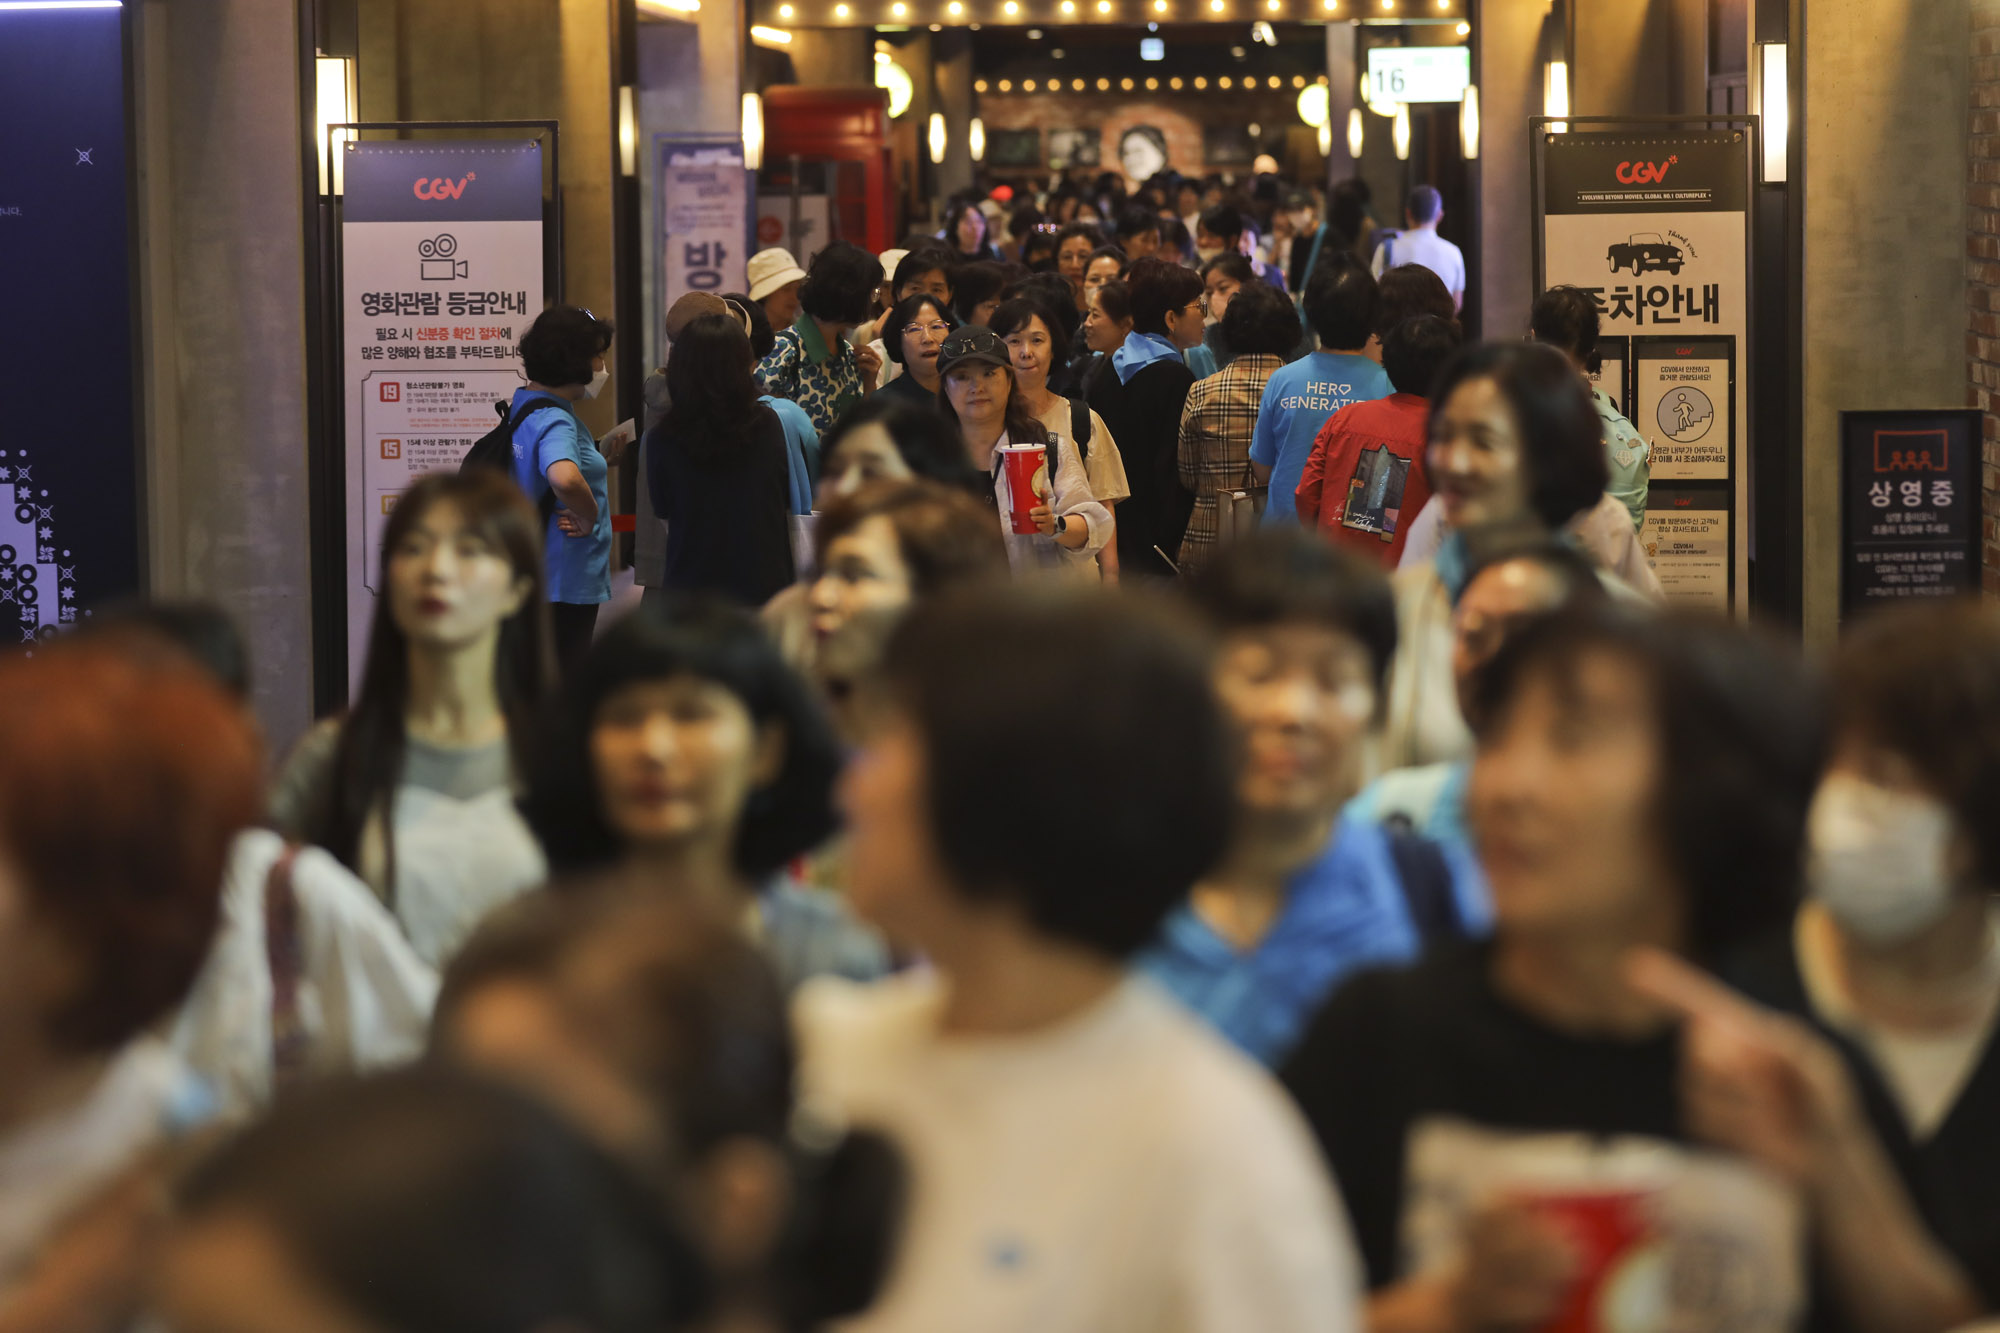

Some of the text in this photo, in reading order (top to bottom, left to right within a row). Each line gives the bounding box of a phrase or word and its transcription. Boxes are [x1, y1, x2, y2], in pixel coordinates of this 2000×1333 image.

[1376, 68, 1405, 93] 16
[1616, 161, 1670, 184] CGV
[414, 177, 468, 200] CGV
[1668, 230, 1688, 244] Thank
[361, 291, 526, 316] 영화관람 등급안내
[376, 328, 512, 340] 필요 시 신분증 확인 절차에
[361, 346, 384, 360] 많은
[387, 346, 420, 360] 양해와
[424, 346, 456, 359] 협조를
[384, 385, 398, 400] 19
[384, 442, 398, 457] 15
